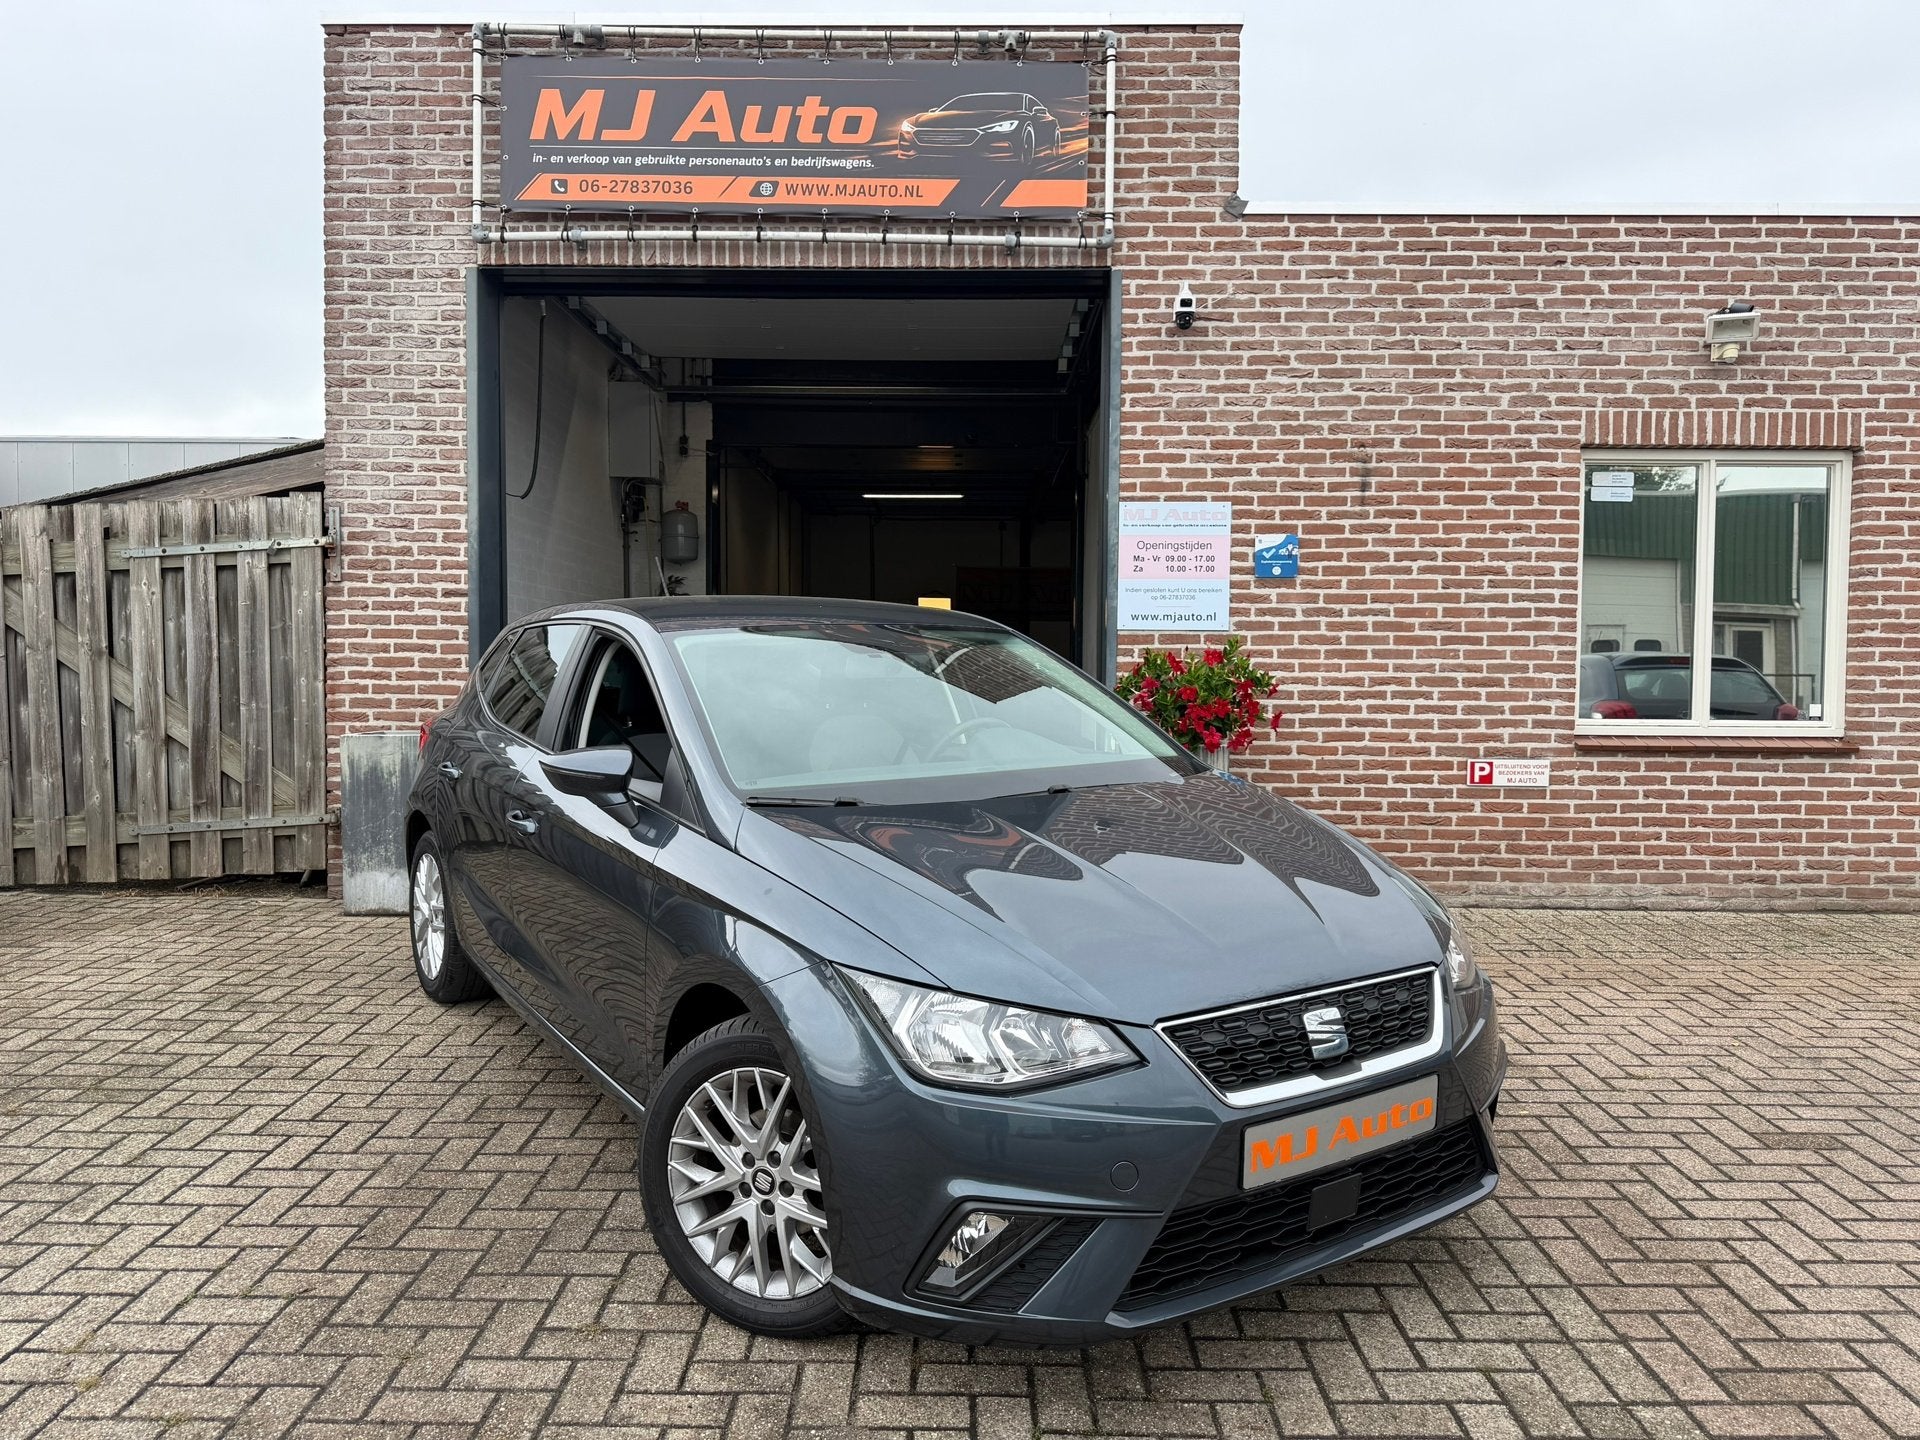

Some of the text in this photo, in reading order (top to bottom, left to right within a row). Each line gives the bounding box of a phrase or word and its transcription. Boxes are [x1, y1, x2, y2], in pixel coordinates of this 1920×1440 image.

[529, 88, 878, 144] MJ Auto
[532, 153, 875, 169] in- en verkoop van gebruikte personenauto's en bedrijfswagens.
[579, 179, 693, 195] 06-27837036
[785, 183, 923, 198] WWW.MJAUTO.NL
[1123, 508, 1228, 521] MJ Auto
[1136, 540, 1212, 552] Openingstijden
[1131, 612, 1217, 623] www.mjauto.nl
[1474, 762, 1490, 783] P
[1250, 1097, 1434, 1173] MJ Auto
